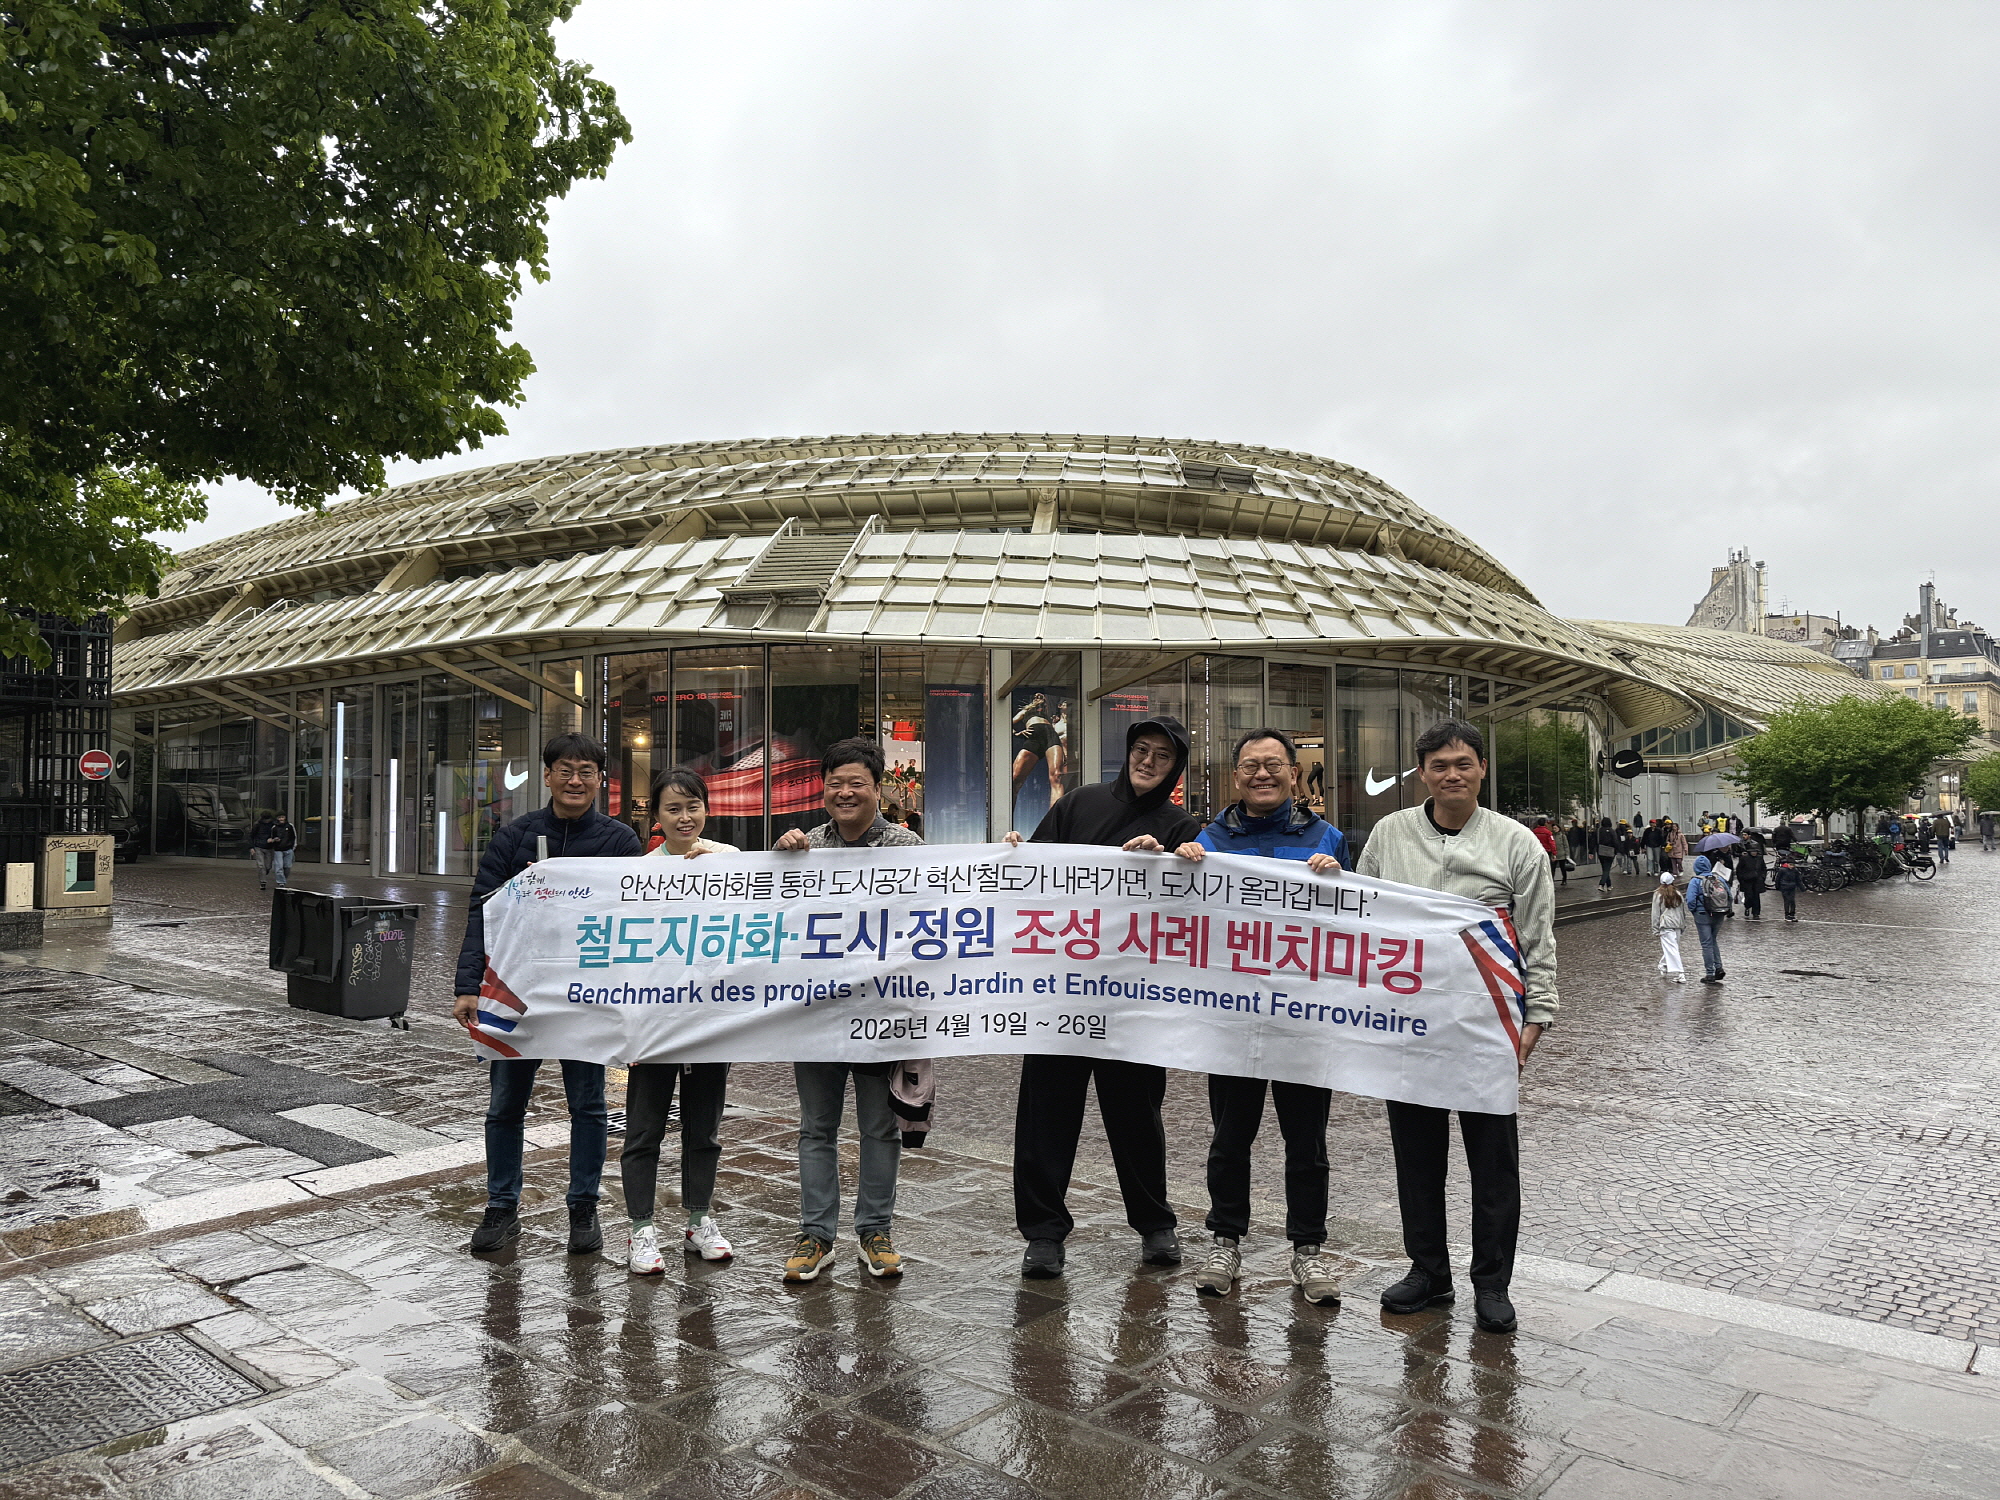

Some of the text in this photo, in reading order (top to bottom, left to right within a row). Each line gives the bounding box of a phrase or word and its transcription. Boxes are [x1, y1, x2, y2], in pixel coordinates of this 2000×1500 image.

[653, 693, 694, 702] VOERO
[568, 886, 594, 899] 안산
[620, 871, 774, 902] 안산선지하화를
[779, 869, 826, 899] 통한
[829, 867, 921, 896] 도시공간
[1053, 865, 1153, 900] 내려가면,
[1159, 871, 1234, 904] 도시가
[1011, 908, 1101, 960] 조성
[1117, 911, 1210, 969] 사례
[1226, 920, 1424, 995] 벤치마킹
[567, 979, 703, 1005] Benchmark
[711, 979, 756, 1002] des
[764, 978, 853, 1008] projets
[873, 975, 935, 1001] Ville,
[943, 971, 1024, 997] Jardin
[1032, 974, 1057, 995] et
[1065, 972, 1261, 1014] Enfouissement
[1270, 992, 1428, 1037] Ferroviaire
[849, 1015, 928, 1040] 2025년
[936, 1013, 971, 1038] 4월
[980, 1011, 1028, 1036] 19일
[1057, 1014, 1107, 1040] 26일
